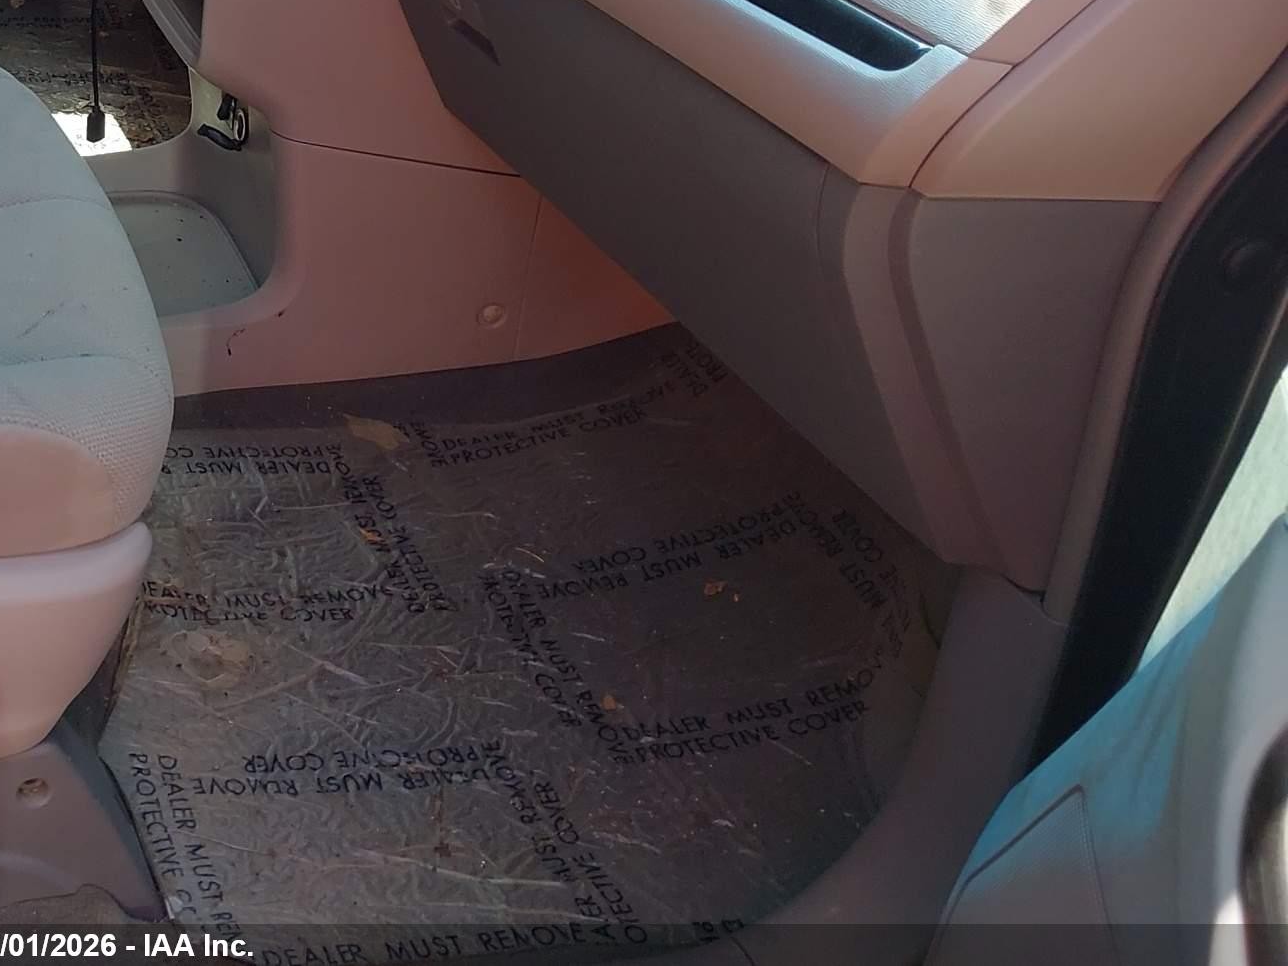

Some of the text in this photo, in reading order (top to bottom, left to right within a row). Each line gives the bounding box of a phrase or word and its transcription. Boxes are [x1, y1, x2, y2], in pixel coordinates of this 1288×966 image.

[452, 408, 648, 464] PROTECTIVE COVER
[205, 445, 324, 459] PROTECTIVE
[185, 462, 242, 475] MUST
[258, 460, 331, 475] DEALER
[643, 551, 702, 582] MUST
[225, 591, 285, 608] MUST
[539, 572, 628, 600] REMOVE
[280, 606, 355, 623] COVER
[540, 639, 584, 683] MUST
[622, 714, 712, 741] DEALER
[725, 698, 794, 725] MUST
[635, 700, 871, 764] PROTECTIVE COVER
[241, 752, 324, 774] COVER
[192, 777, 296, 797] REMOVE
[315, 772, 384, 794] MUST
[128, 752, 185, 878] PROTECTIVE
[157, 754, 198, 834] DEALER
[184, 843, 224, 903] MUST
[263, 921, 586, 966] DEALER MUST REMOVE
